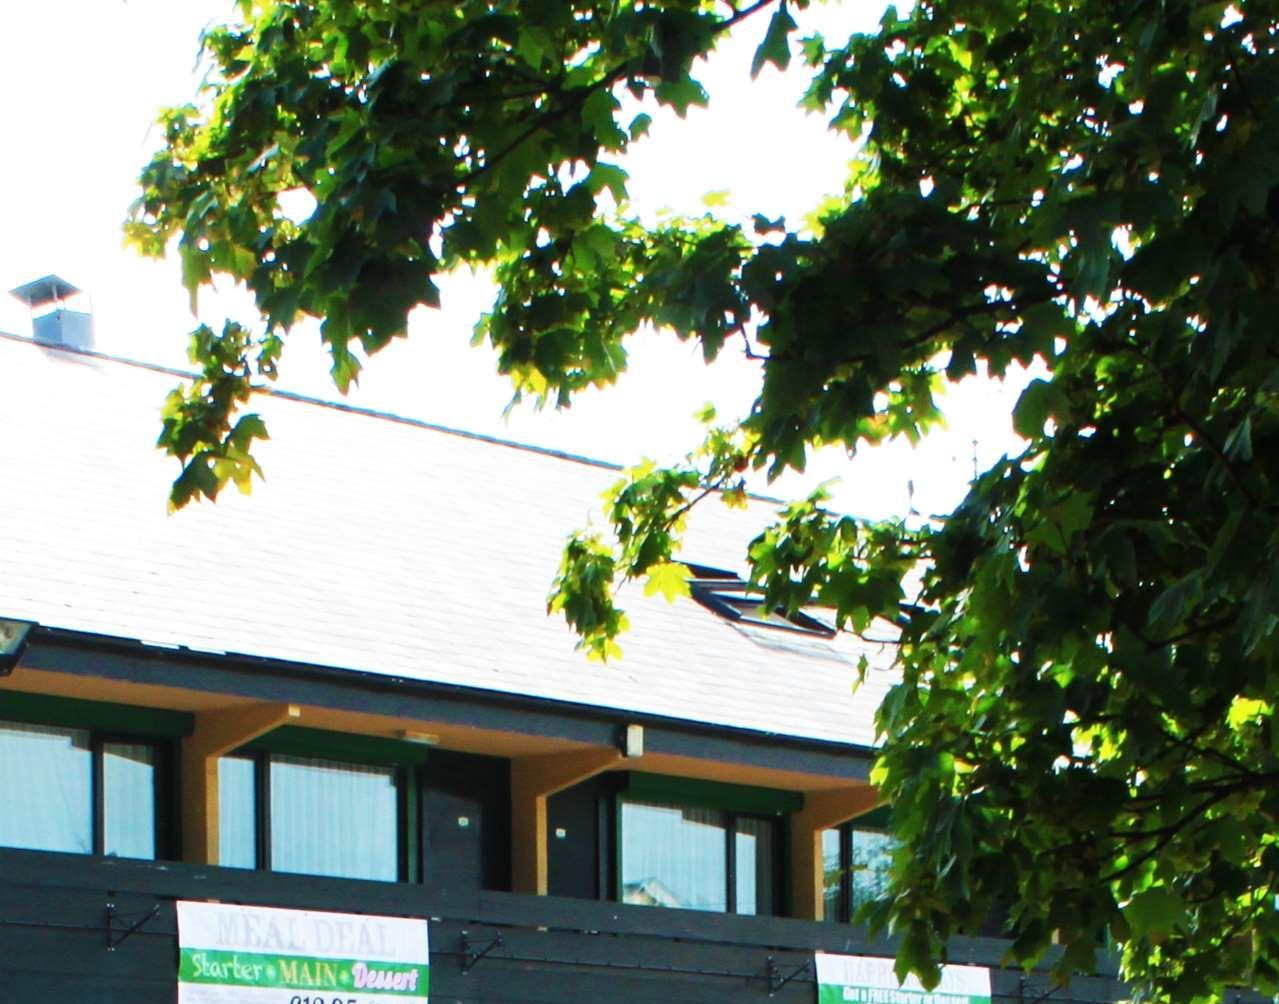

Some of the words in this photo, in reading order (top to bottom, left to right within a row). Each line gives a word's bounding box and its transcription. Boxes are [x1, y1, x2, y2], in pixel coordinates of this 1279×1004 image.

[216, 911, 306, 952] MEAL
[311, 918, 397, 957] DEAL
[192, 953, 263, 981] Starter
[279, 959, 338, 987] MAIN
[352, 962, 418, 990] Dessert
